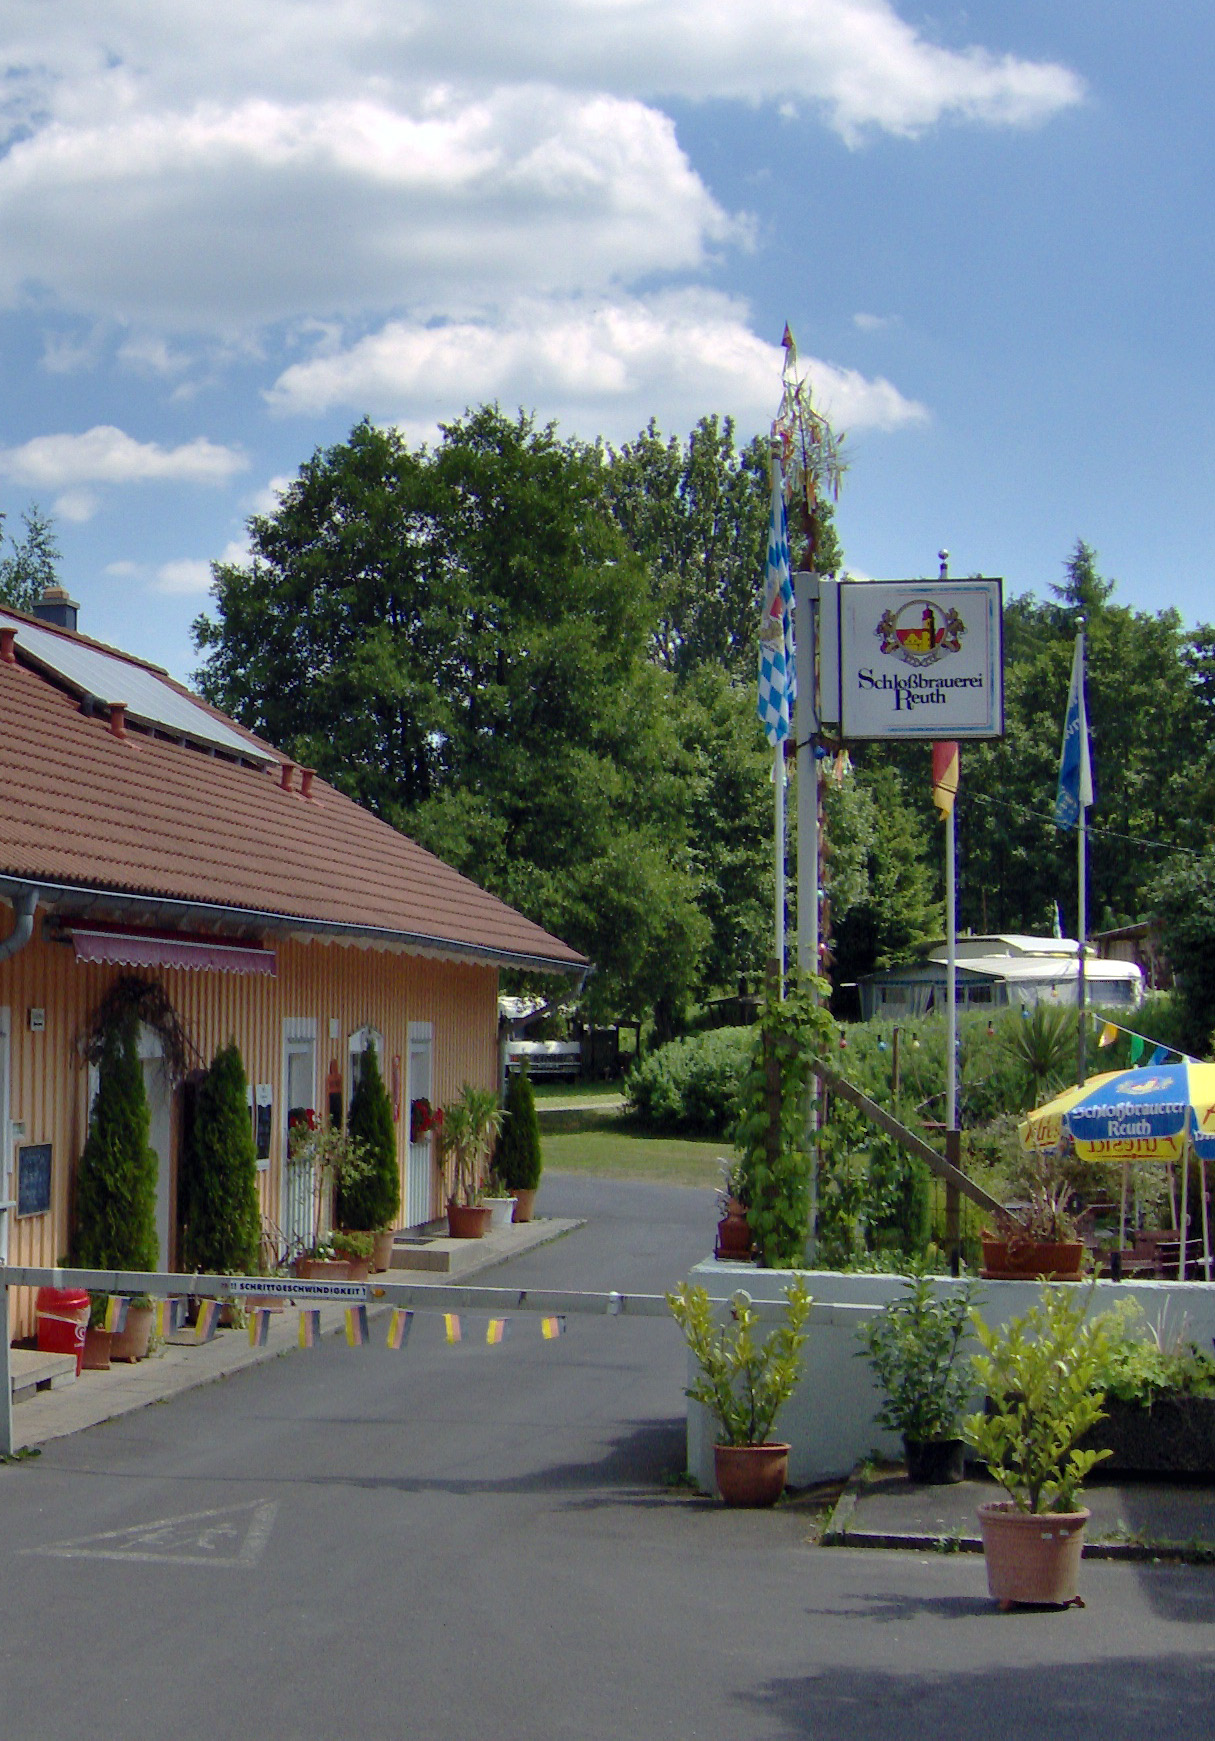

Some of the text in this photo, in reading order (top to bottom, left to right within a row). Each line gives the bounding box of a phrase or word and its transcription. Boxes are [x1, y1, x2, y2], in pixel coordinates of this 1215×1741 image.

[857, 667, 983, 691] Schloßbrauerei
[893, 688, 946, 711] Reuth
[1072, 1101, 1186, 1121] Schloßbrauerei
[1108, 1120, 1152, 1138] Reuth
[239, 1282, 360, 1296] SCHRITTGESCHWINDIGKEIT
